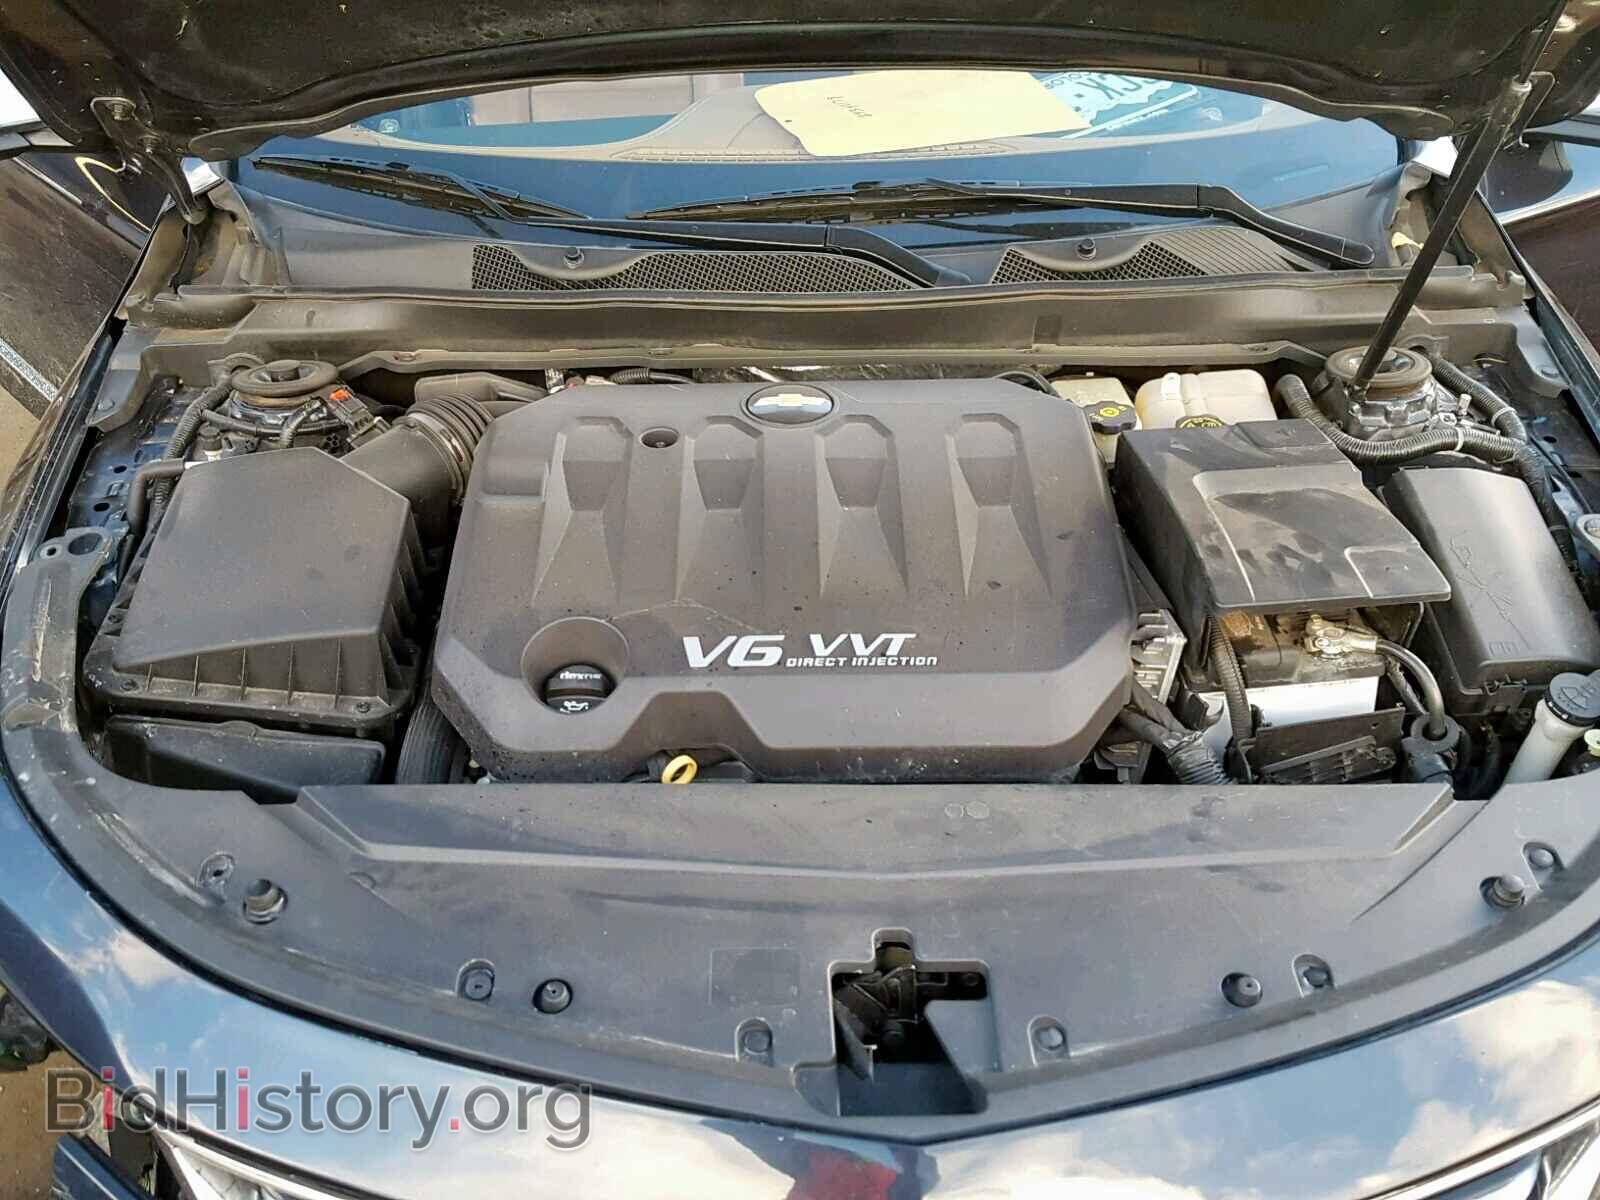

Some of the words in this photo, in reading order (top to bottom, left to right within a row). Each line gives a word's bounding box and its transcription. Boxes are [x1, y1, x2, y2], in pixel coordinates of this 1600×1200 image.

[682, 635, 785, 668] V6
[809, 633, 917, 656] VVT
[786, 657, 848, 667] DIRECT
[852, 656, 938, 667] INJECTION
